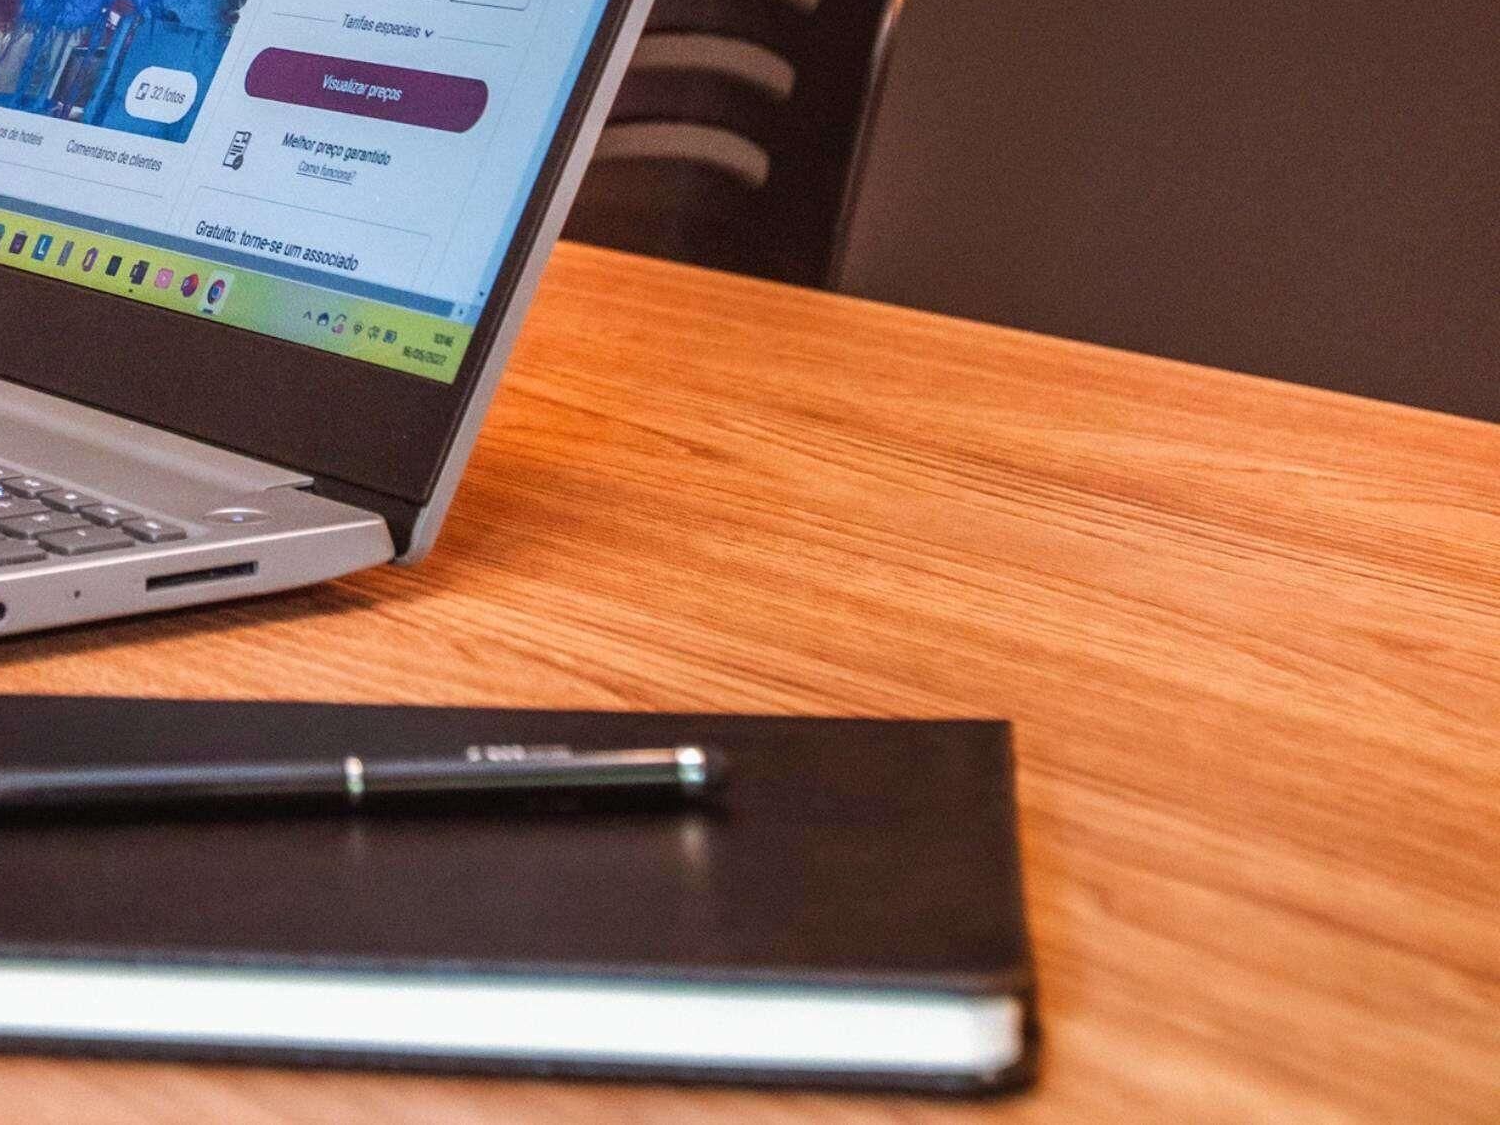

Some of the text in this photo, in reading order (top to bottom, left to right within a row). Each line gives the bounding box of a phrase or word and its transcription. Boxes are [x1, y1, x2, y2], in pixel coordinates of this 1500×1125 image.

[374, 20, 421, 38] especiais
[163, 88, 186, 105] fotos
[322, 75, 403, 103] Visualizar preços
[282, 132, 391, 166] Melhor preço garantido
[117, 151, 130, 165] de
[128, 152, 163, 172] clientes
[196, 220, 359, 272] Gratuito: torne-se um associado
